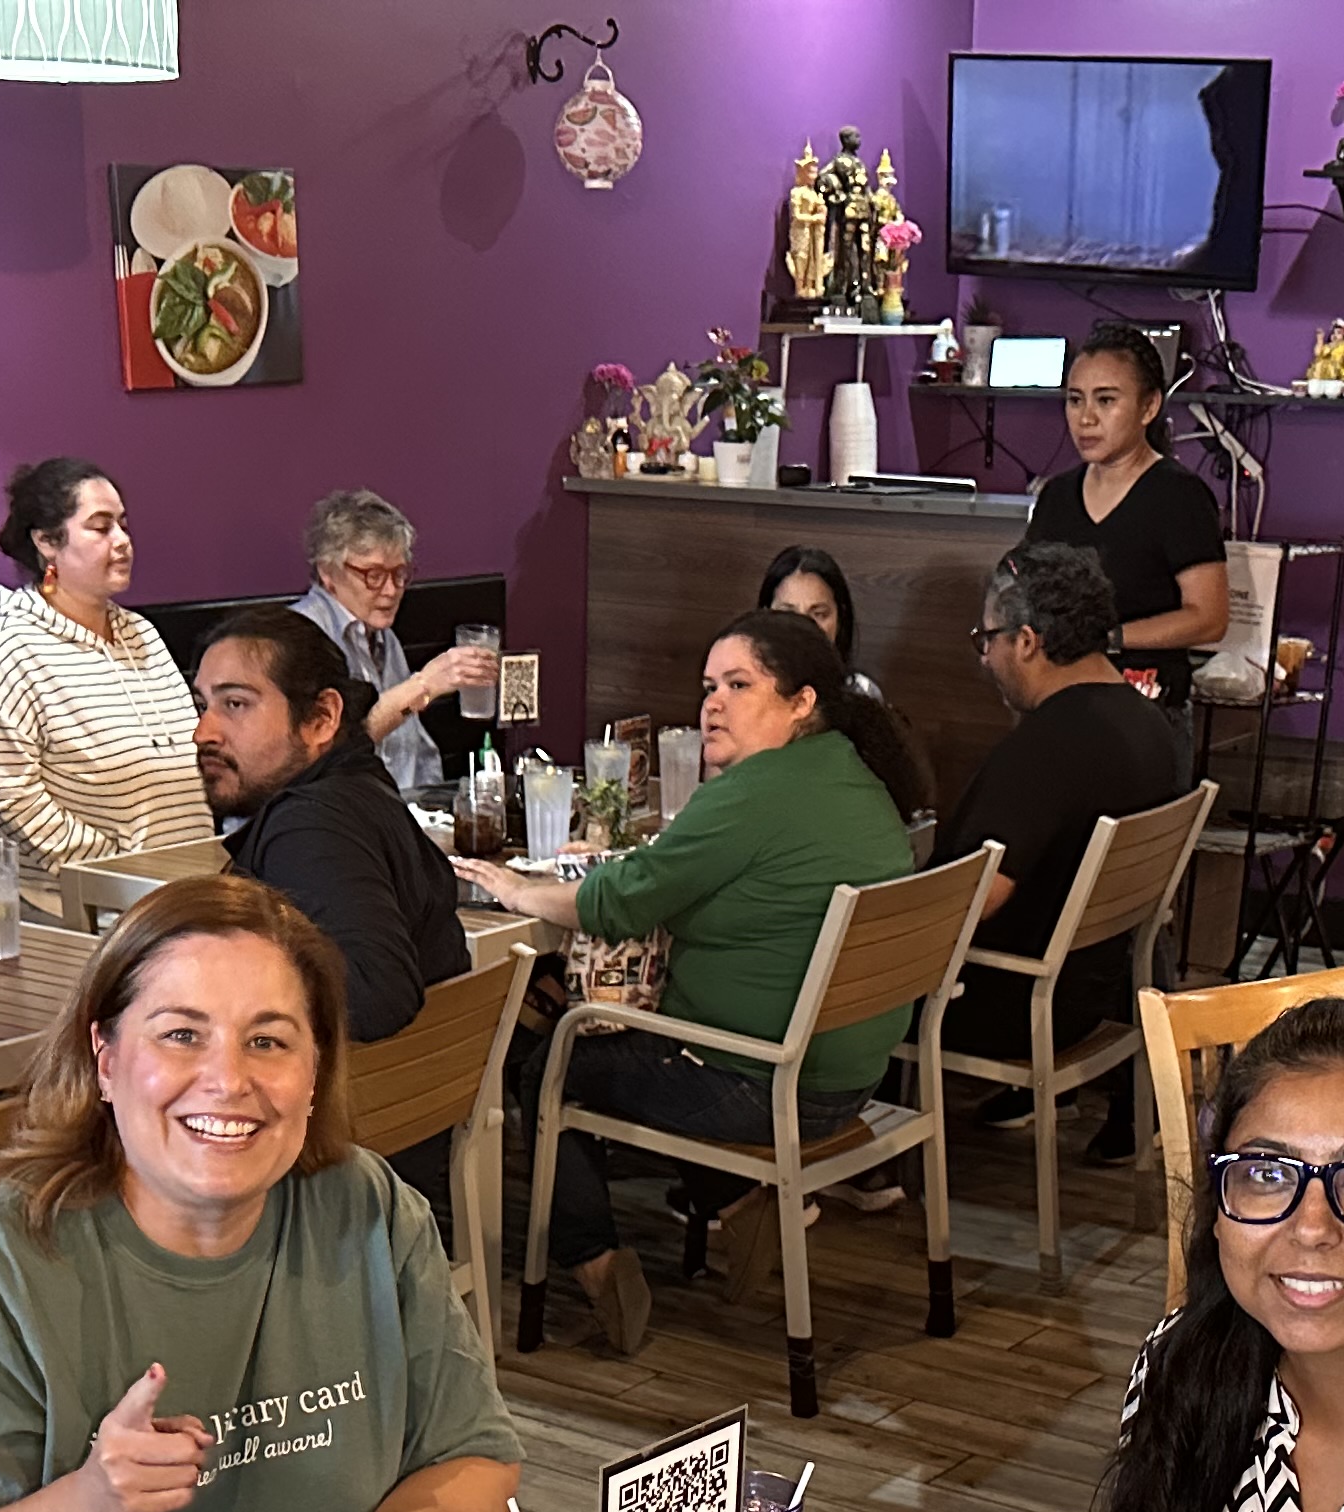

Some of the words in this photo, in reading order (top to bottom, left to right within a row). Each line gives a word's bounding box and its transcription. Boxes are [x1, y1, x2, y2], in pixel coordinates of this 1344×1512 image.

[298, 1370, 368, 1414] card
[218, 1435, 260, 1470] well
[263, 1418, 334, 1460] aware)
